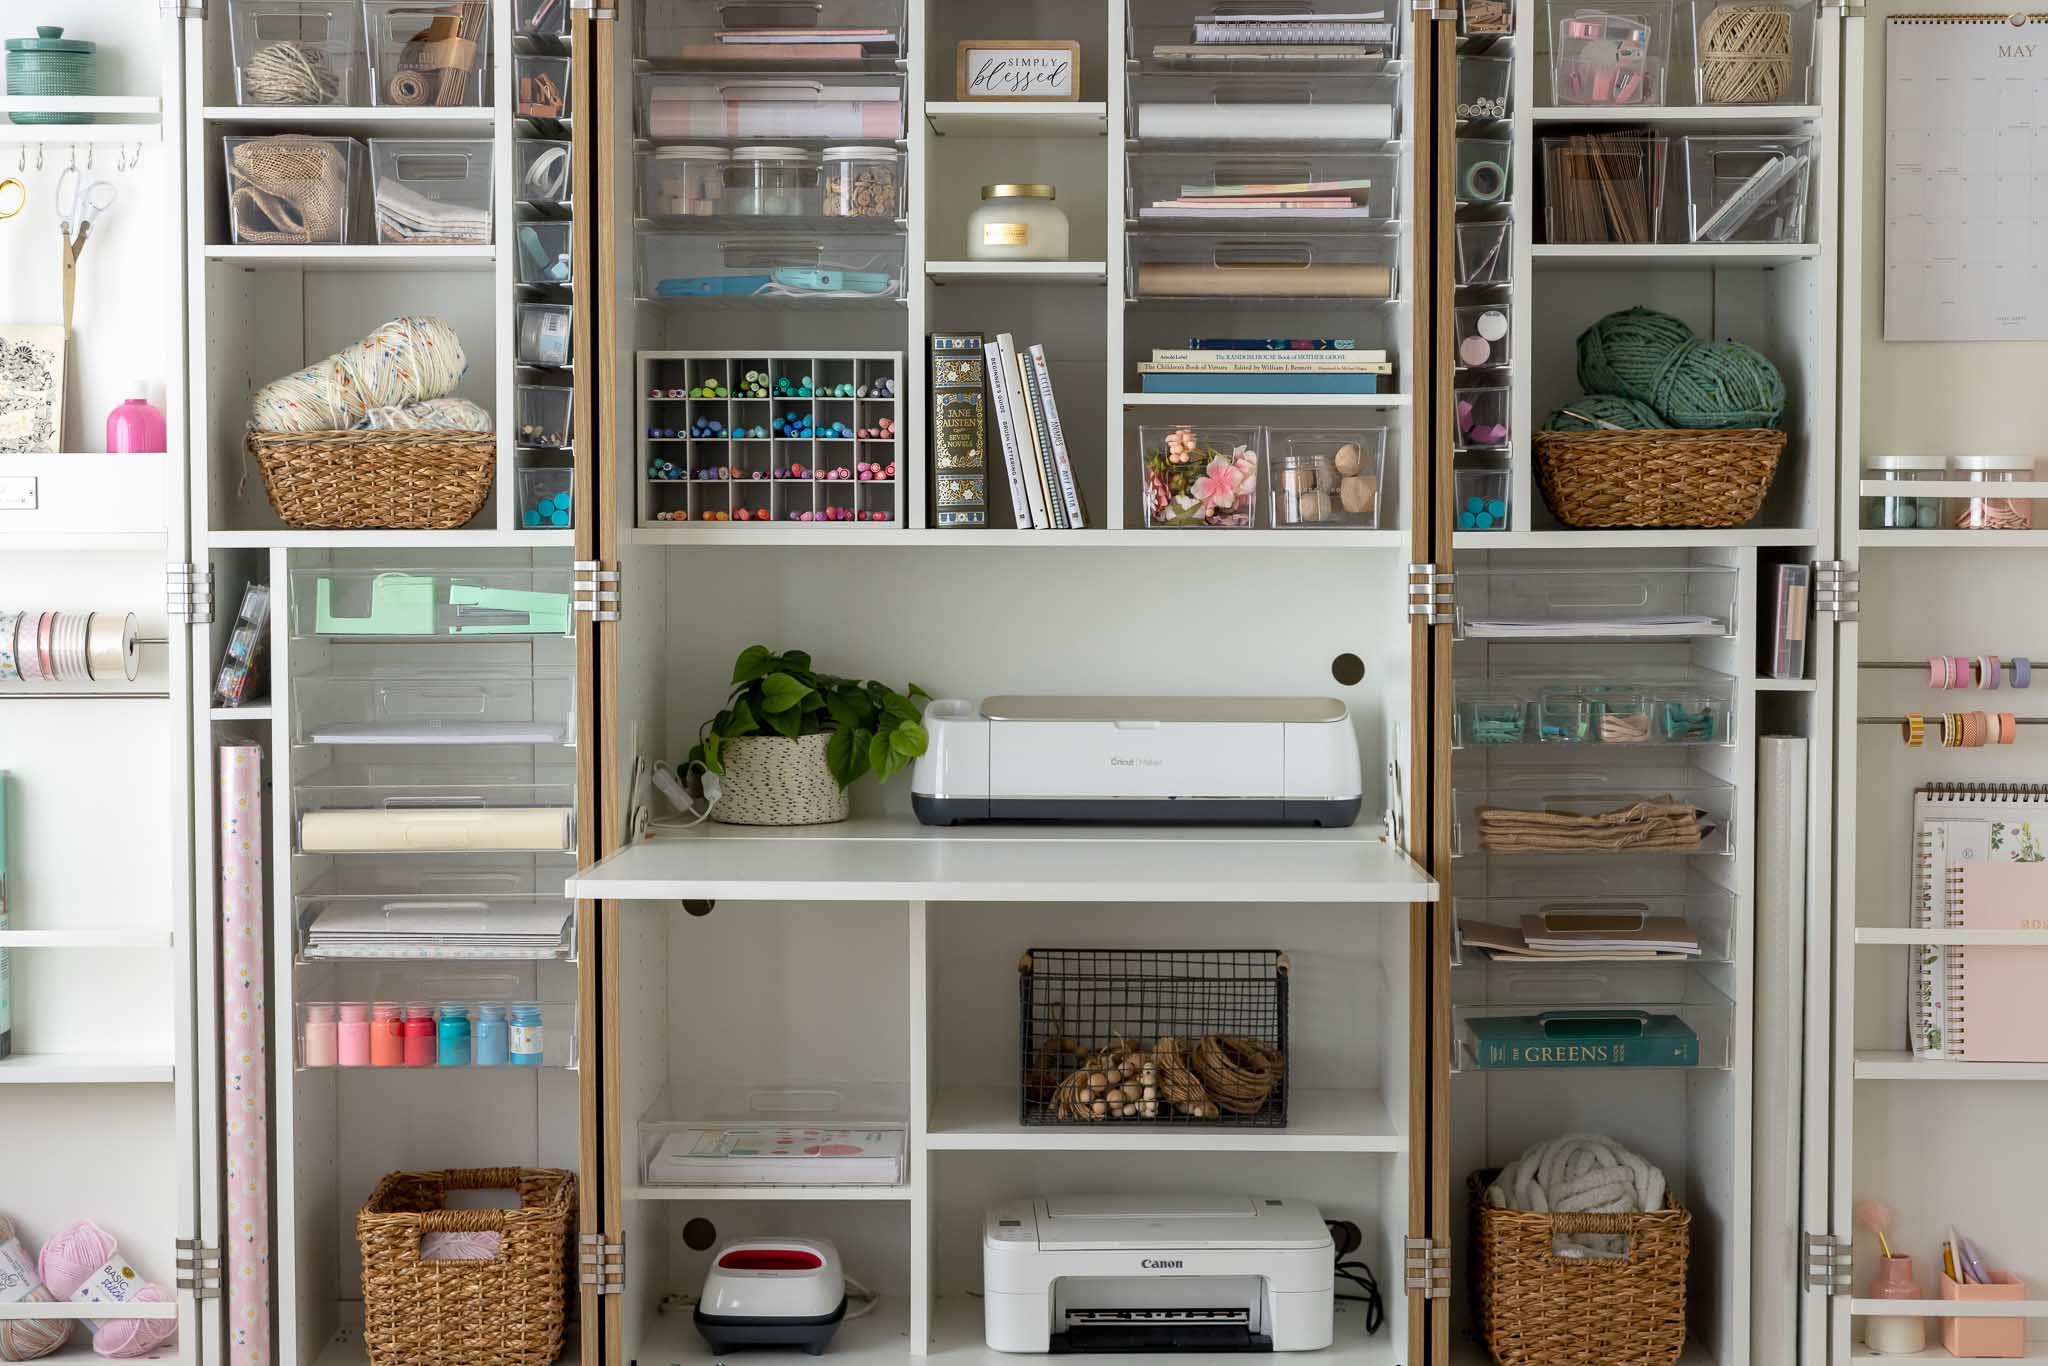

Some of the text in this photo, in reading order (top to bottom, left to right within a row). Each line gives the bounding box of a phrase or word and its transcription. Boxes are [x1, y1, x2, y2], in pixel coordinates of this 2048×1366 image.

[1998, 44, 2037, 58] MAY
[1007, 57, 1059, 67] SIMPLY
[969, 58, 1069, 92] blessed
[947, 409, 971, 418] JANE
[943, 418, 977, 427] AUSTEN
[949, 433, 971, 441] SEVEN
[1002, 421, 1011, 443] BRUSH
[947, 440, 973, 448] NOVELS
[1524, 1046, 1608, 1062] GREENS
[1141, 1258, 1183, 1269] Canon
[104, 1265, 128, 1290] BASIC
[100, 1278, 125, 1302] stitch
